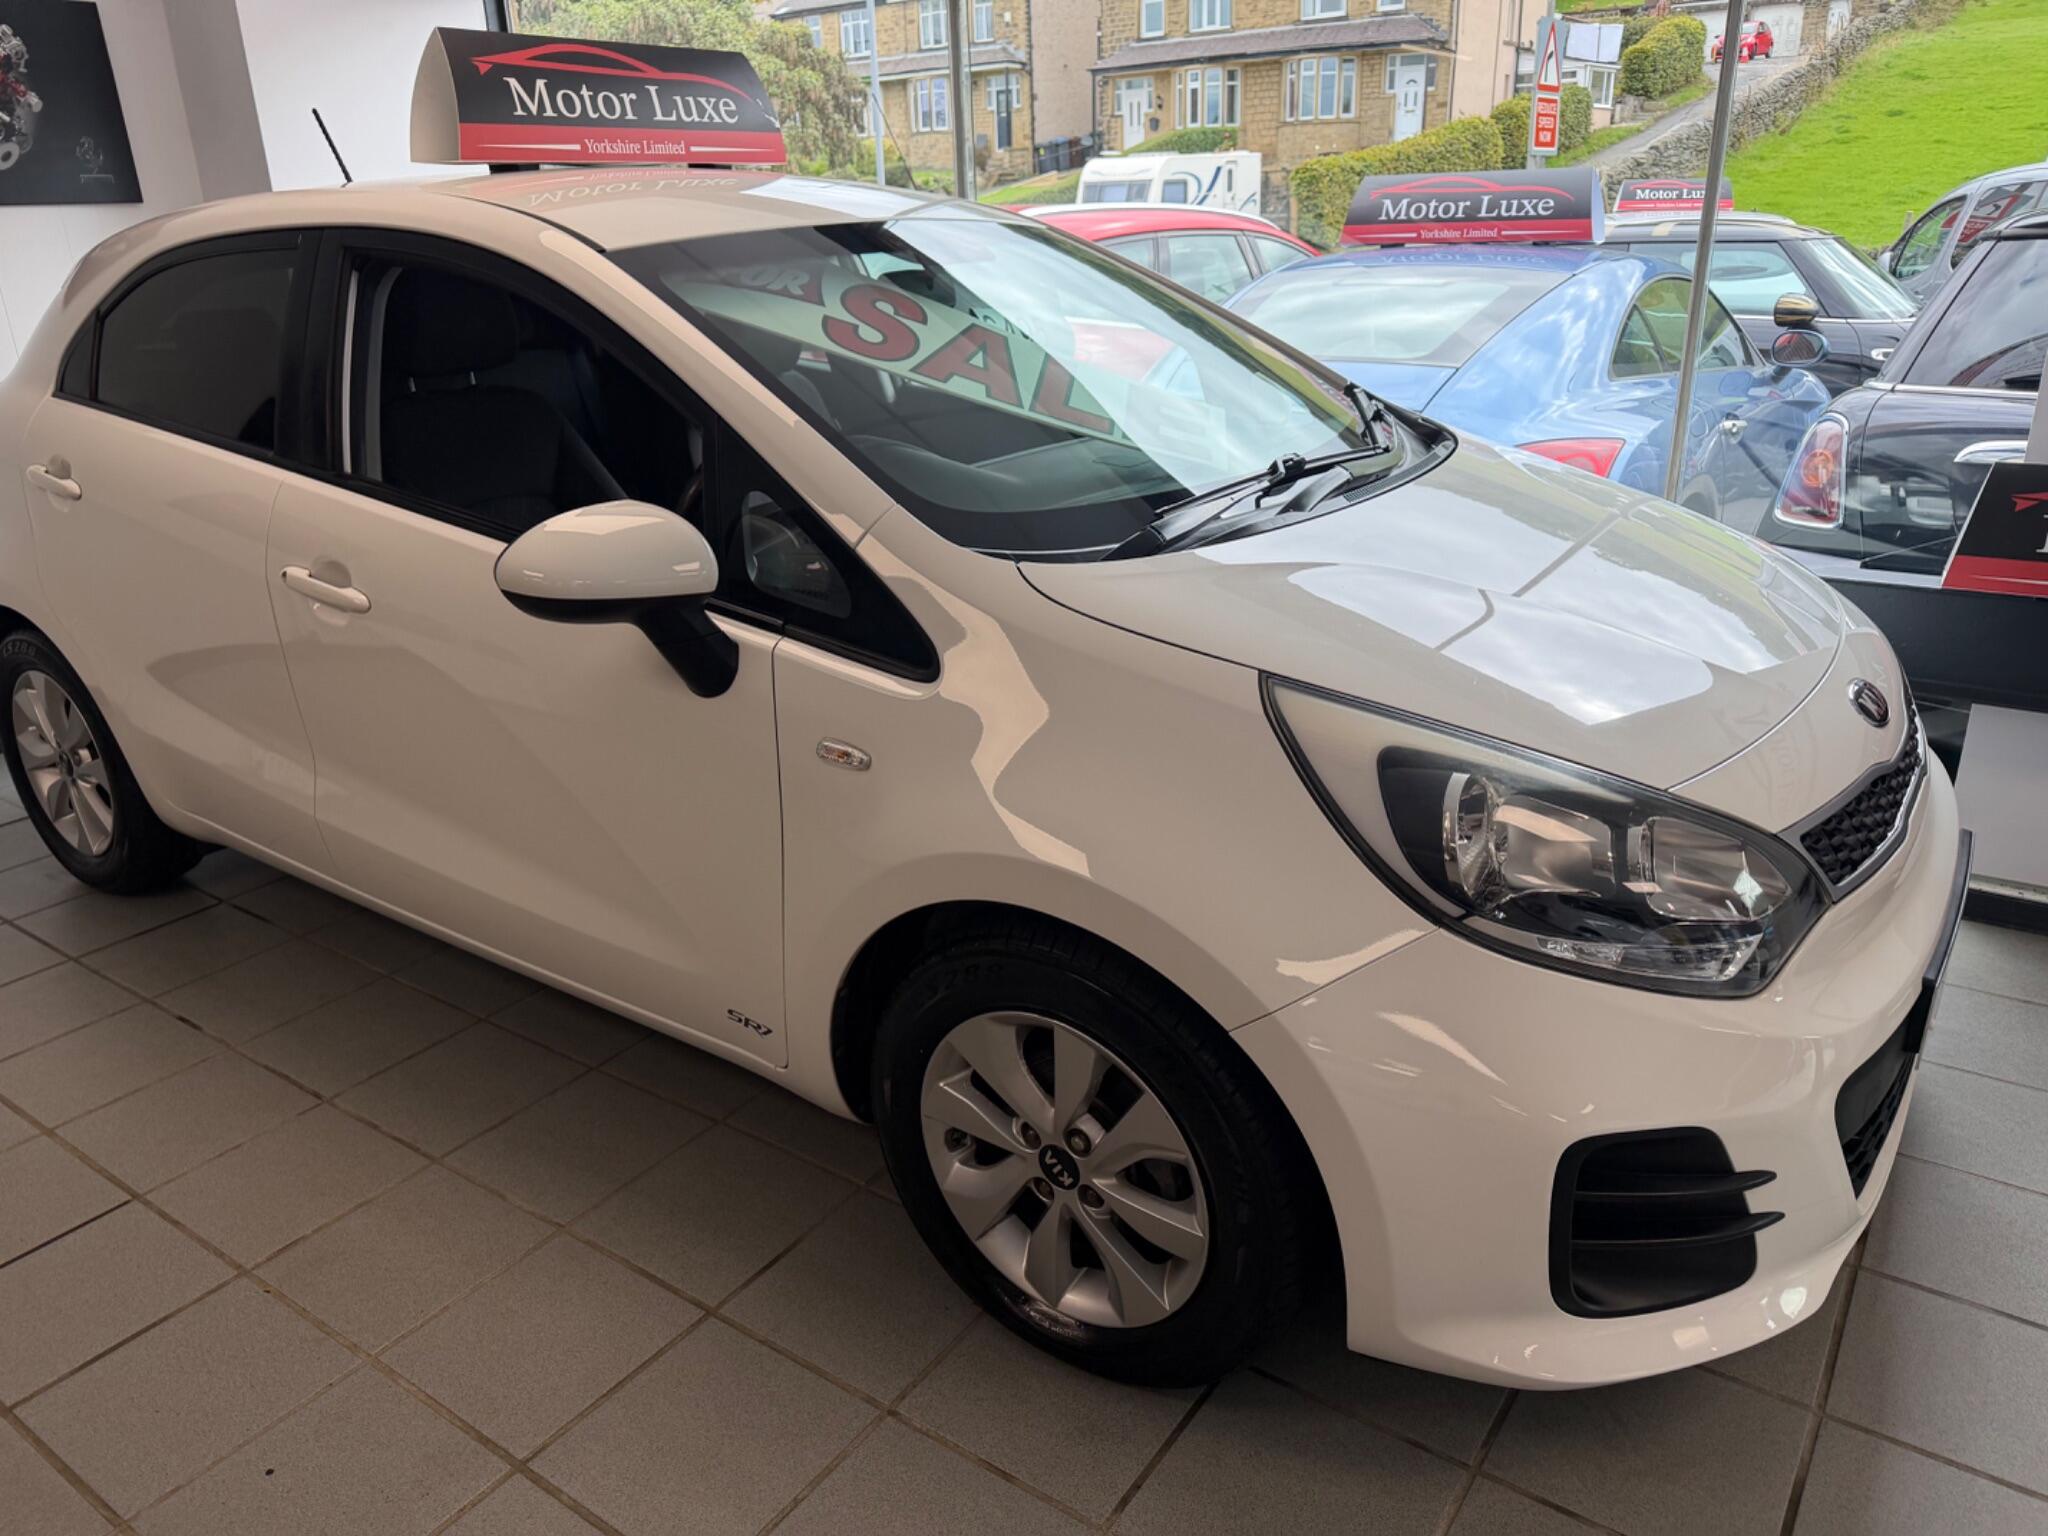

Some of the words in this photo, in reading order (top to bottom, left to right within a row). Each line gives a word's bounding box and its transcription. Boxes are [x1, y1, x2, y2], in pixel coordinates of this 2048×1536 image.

[503, 77, 638, 118] Motor
[644, 85, 738, 123] Luxe
[585, 139, 640, 154] Yorkshire
[643, 141, 685, 155] Limited
[1635, 189, 1679, 199] Motor
[1683, 189, 1706, 199] Lu
[1378, 198, 1469, 220] Motor
[1477, 195, 1554, 218] Luxe
[1420, 229, 1462, 239] Yorkshire
[1463, 227, 1498, 238] Limited
[727, 1008, 773, 1037] SR7
[1044, 1149, 1074, 1187] KIA
